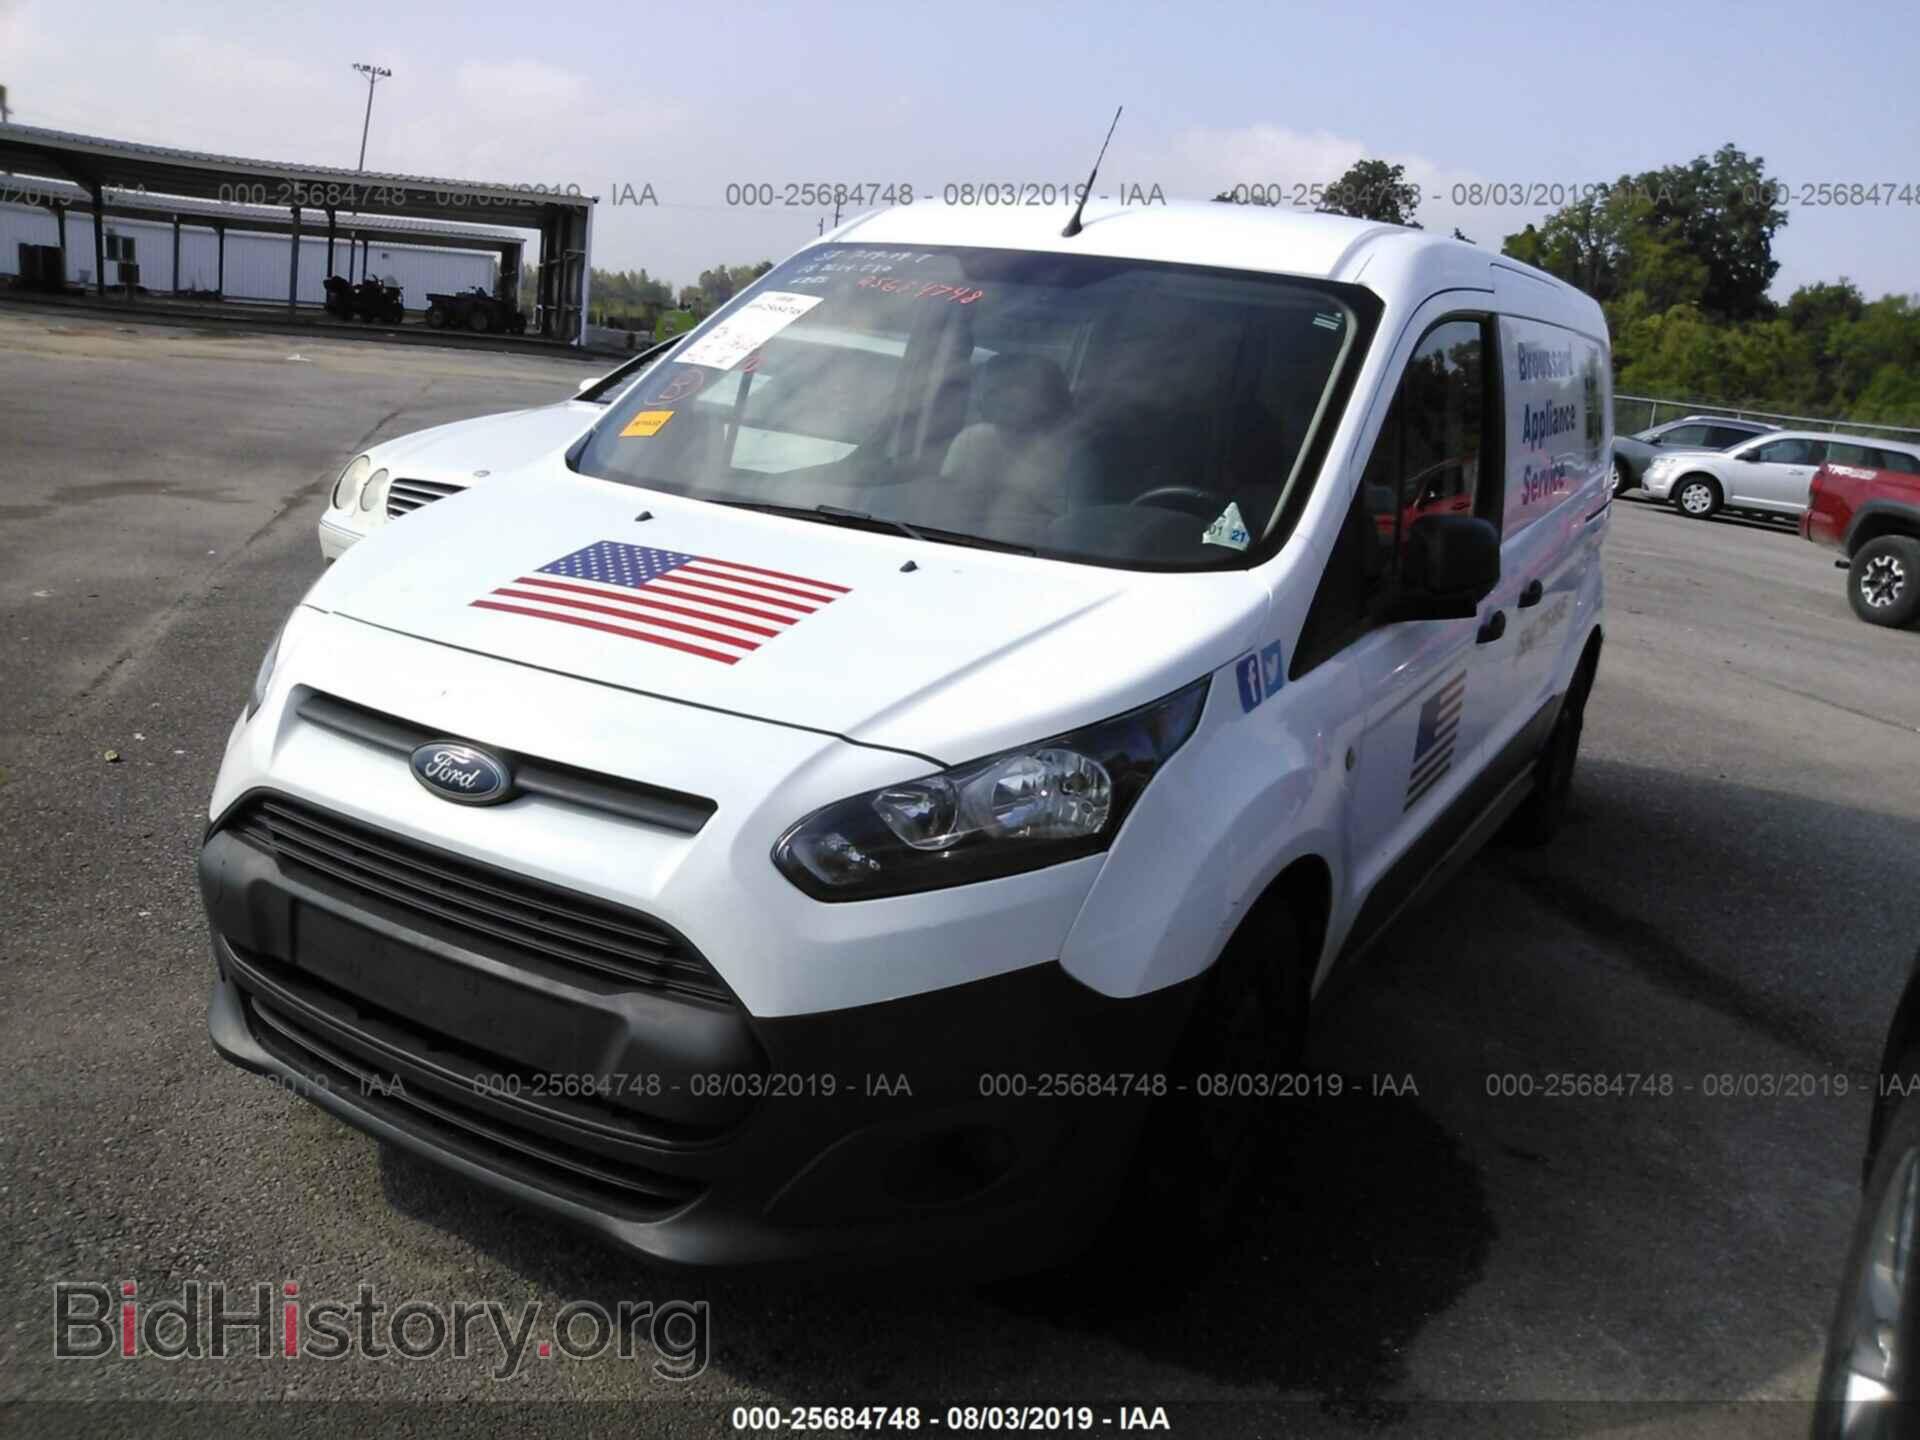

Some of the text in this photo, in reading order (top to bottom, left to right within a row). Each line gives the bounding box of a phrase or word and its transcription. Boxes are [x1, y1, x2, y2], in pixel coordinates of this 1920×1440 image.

[1522, 400, 1577, 451] Appliance
[1521, 456, 1567, 505] Service
[425, 750, 480, 788] Ford
